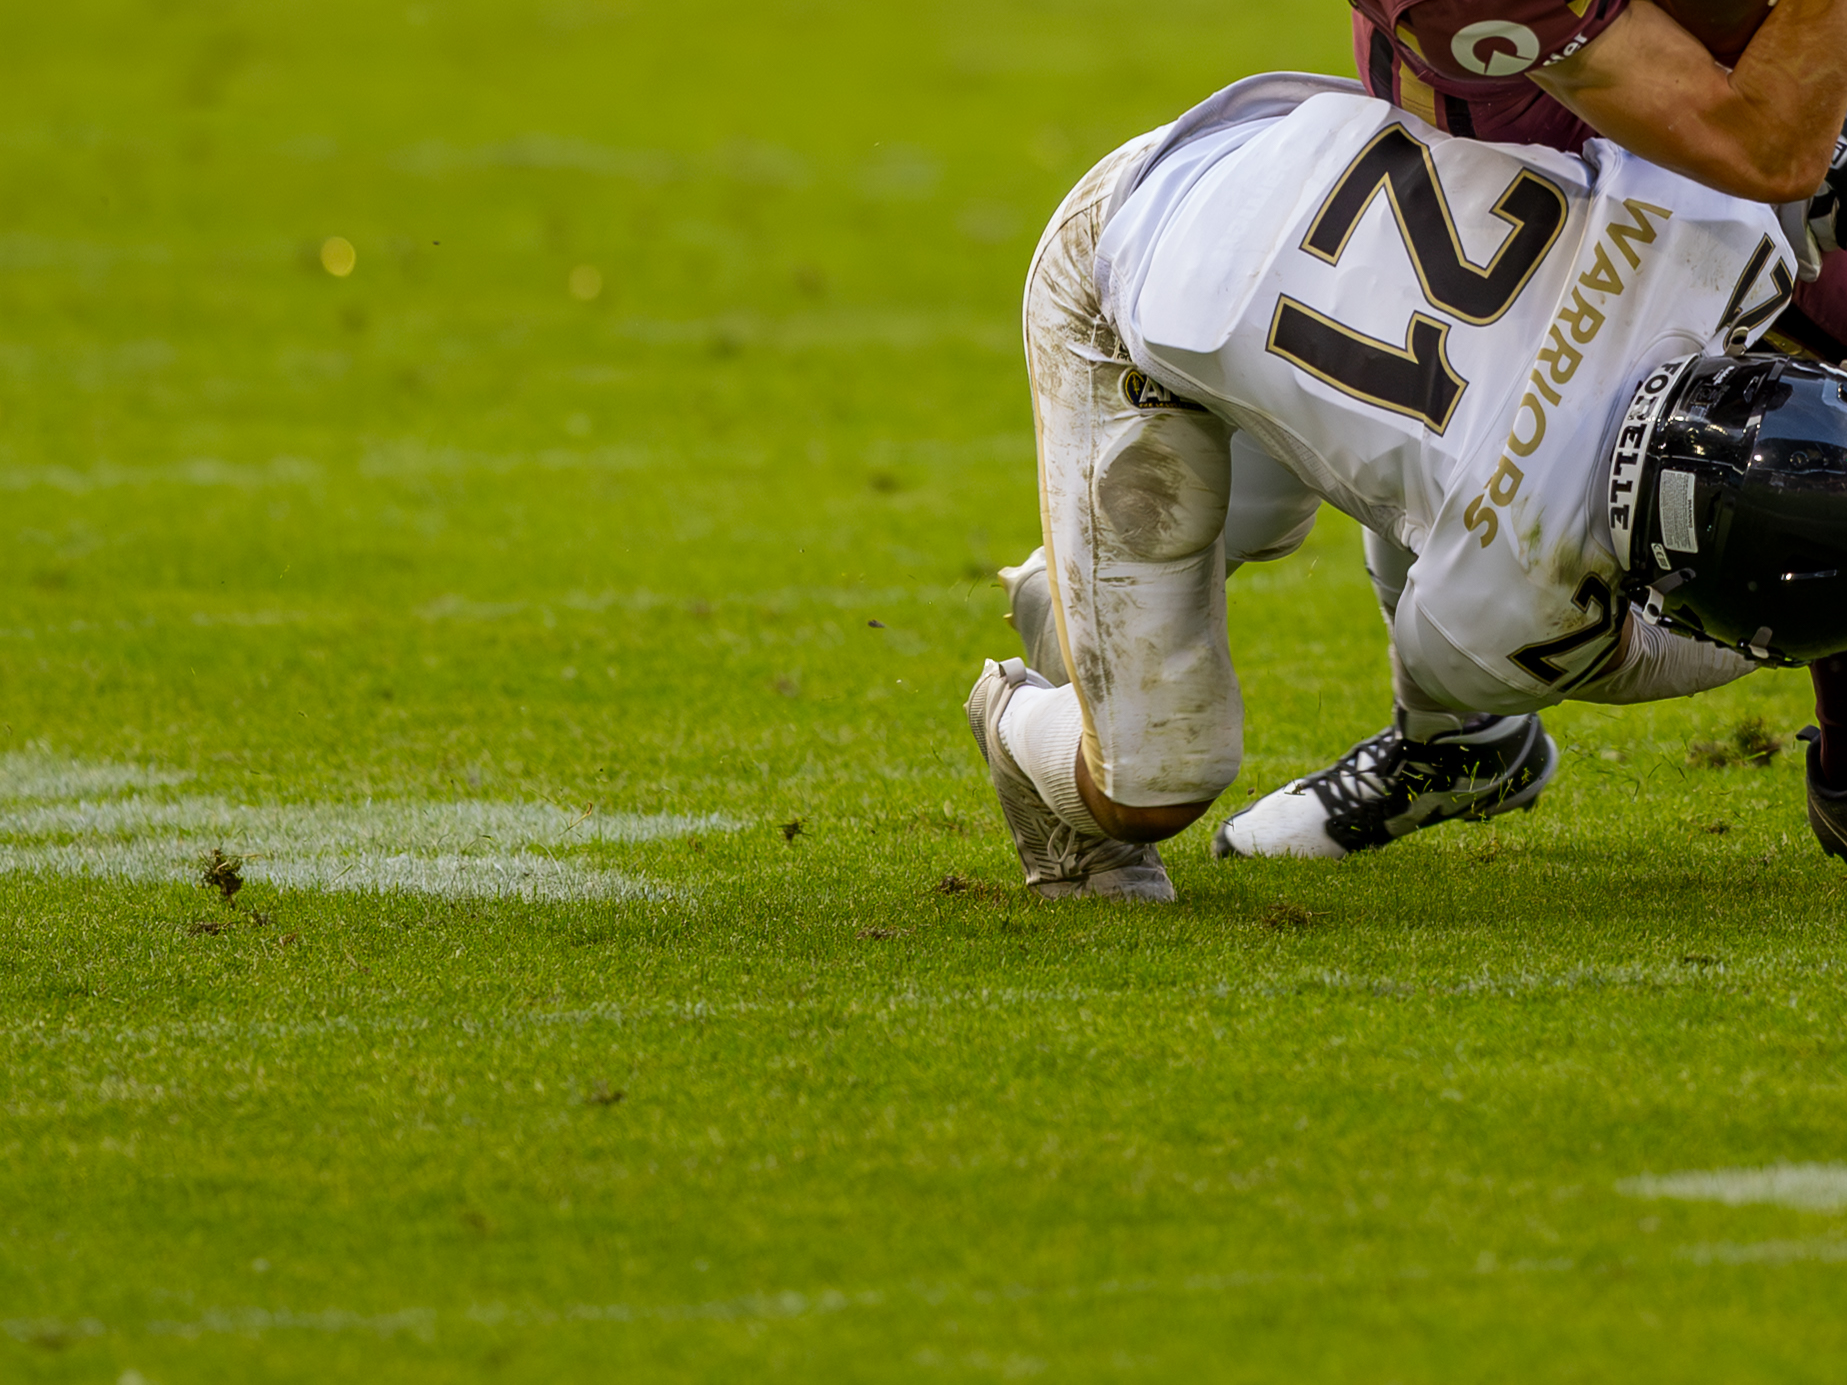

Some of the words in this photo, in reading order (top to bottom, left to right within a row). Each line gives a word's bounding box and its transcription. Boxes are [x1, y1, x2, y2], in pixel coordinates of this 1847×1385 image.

[1265, 121, 1569, 437] 21
[1463, 197, 1672, 549] WARRIORS
[1609, 361, 1685, 531] FORELLE
